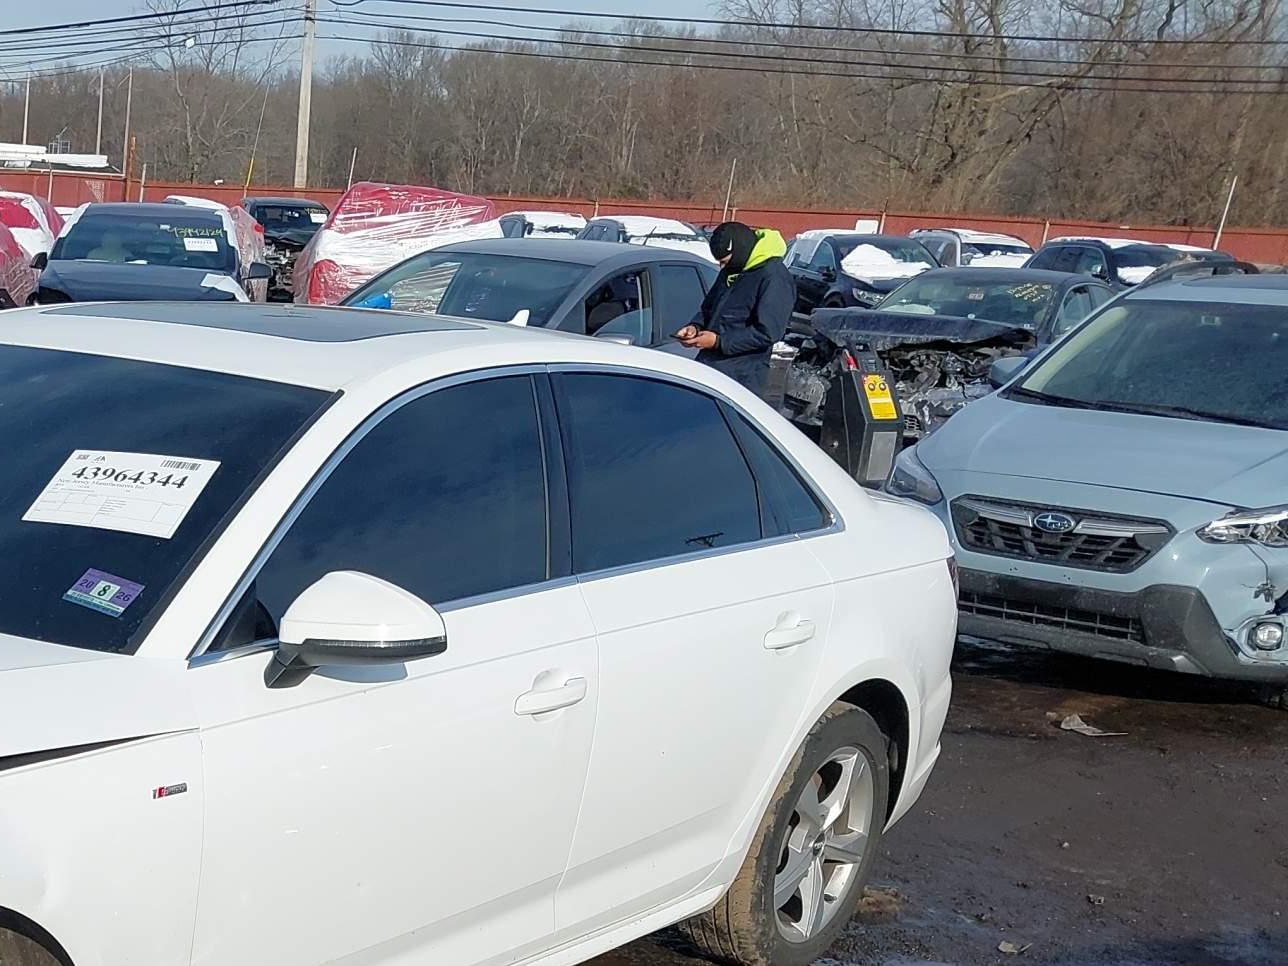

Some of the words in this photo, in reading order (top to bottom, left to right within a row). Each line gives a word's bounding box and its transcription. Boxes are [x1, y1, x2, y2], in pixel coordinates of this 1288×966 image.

[71, 466, 189, 489] 43964344
[79, 578, 95, 589] 20
[97, 584, 112, 597] 8
[115, 591, 132, 602] 26
